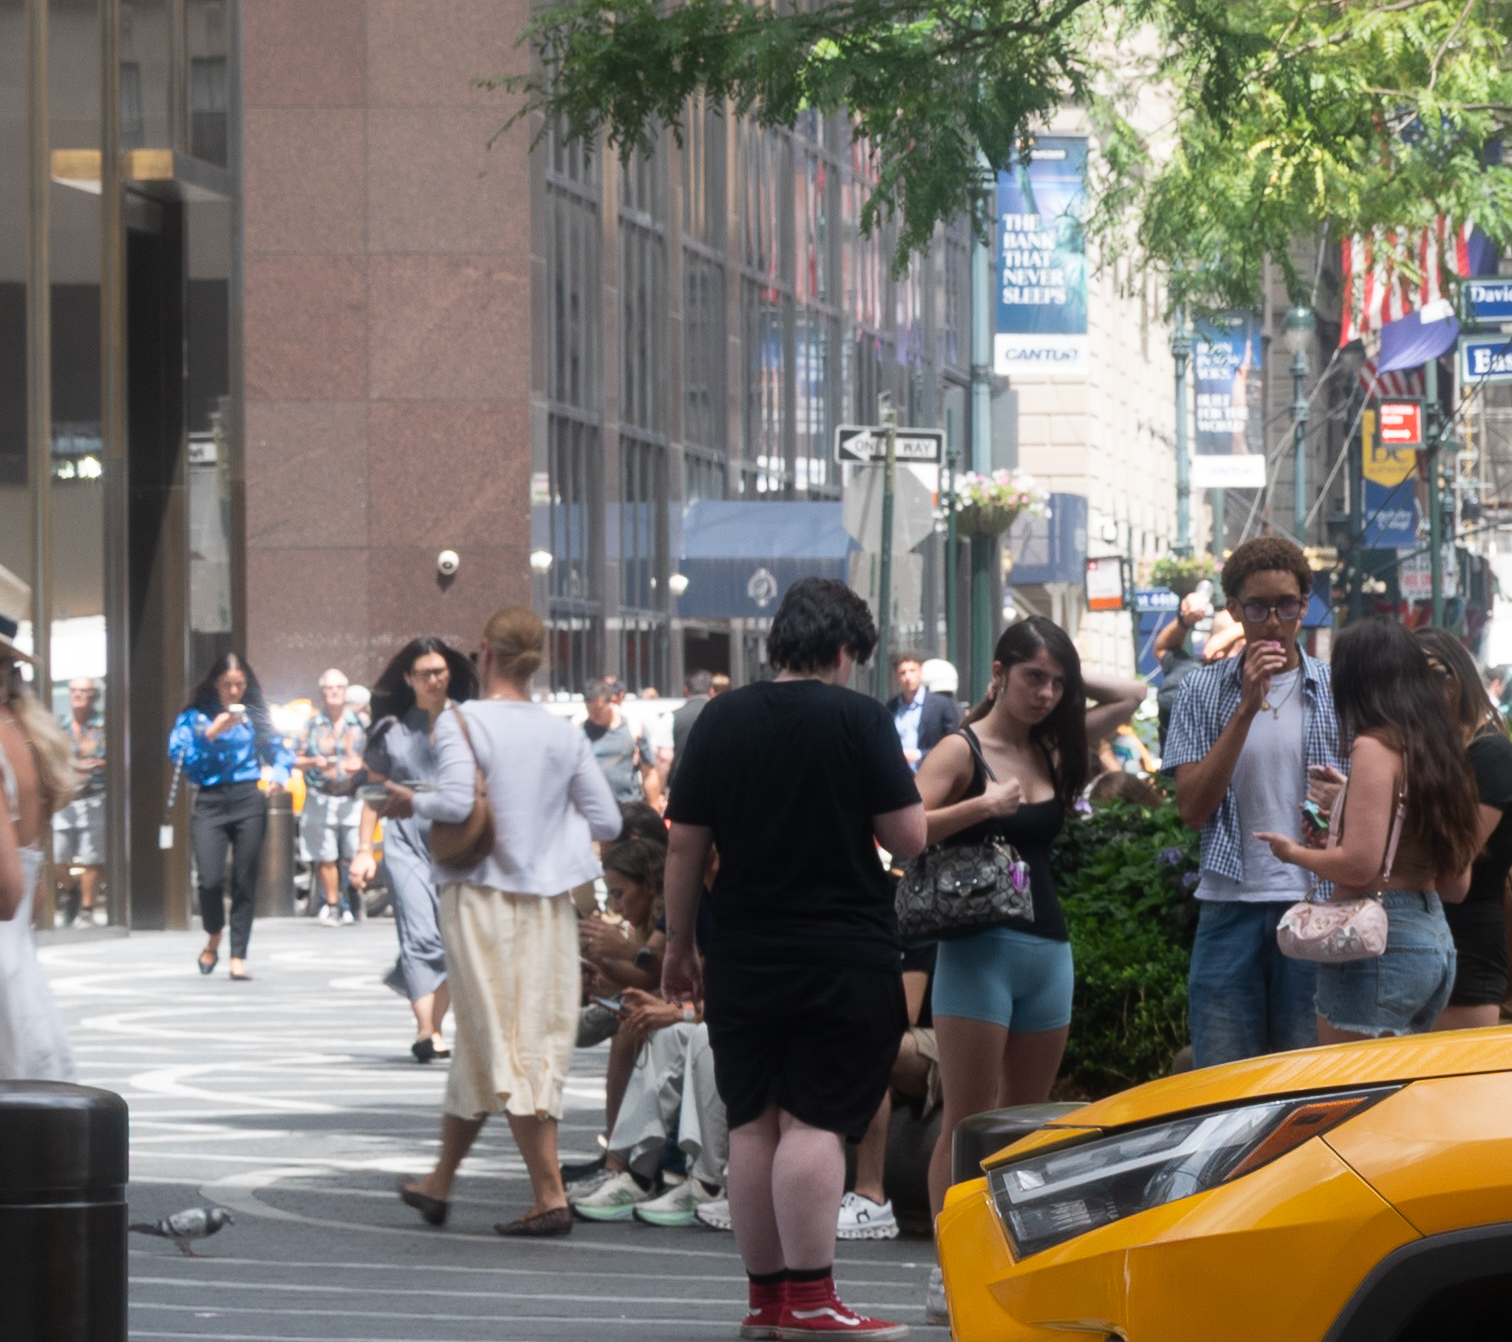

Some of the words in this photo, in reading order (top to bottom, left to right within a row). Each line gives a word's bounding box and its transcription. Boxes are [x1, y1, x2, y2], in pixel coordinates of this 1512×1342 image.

[1003, 214, 1041, 230] THE
[1003, 232, 1056, 250] BANK
[1003, 250, 1051, 267] THAT
[1003, 268, 1064, 286] NEVER
[1003, 287, 1066, 304] SLEEPS
[855, 439, 885, 452] ON
[903, 442, 930, 453] WAY
